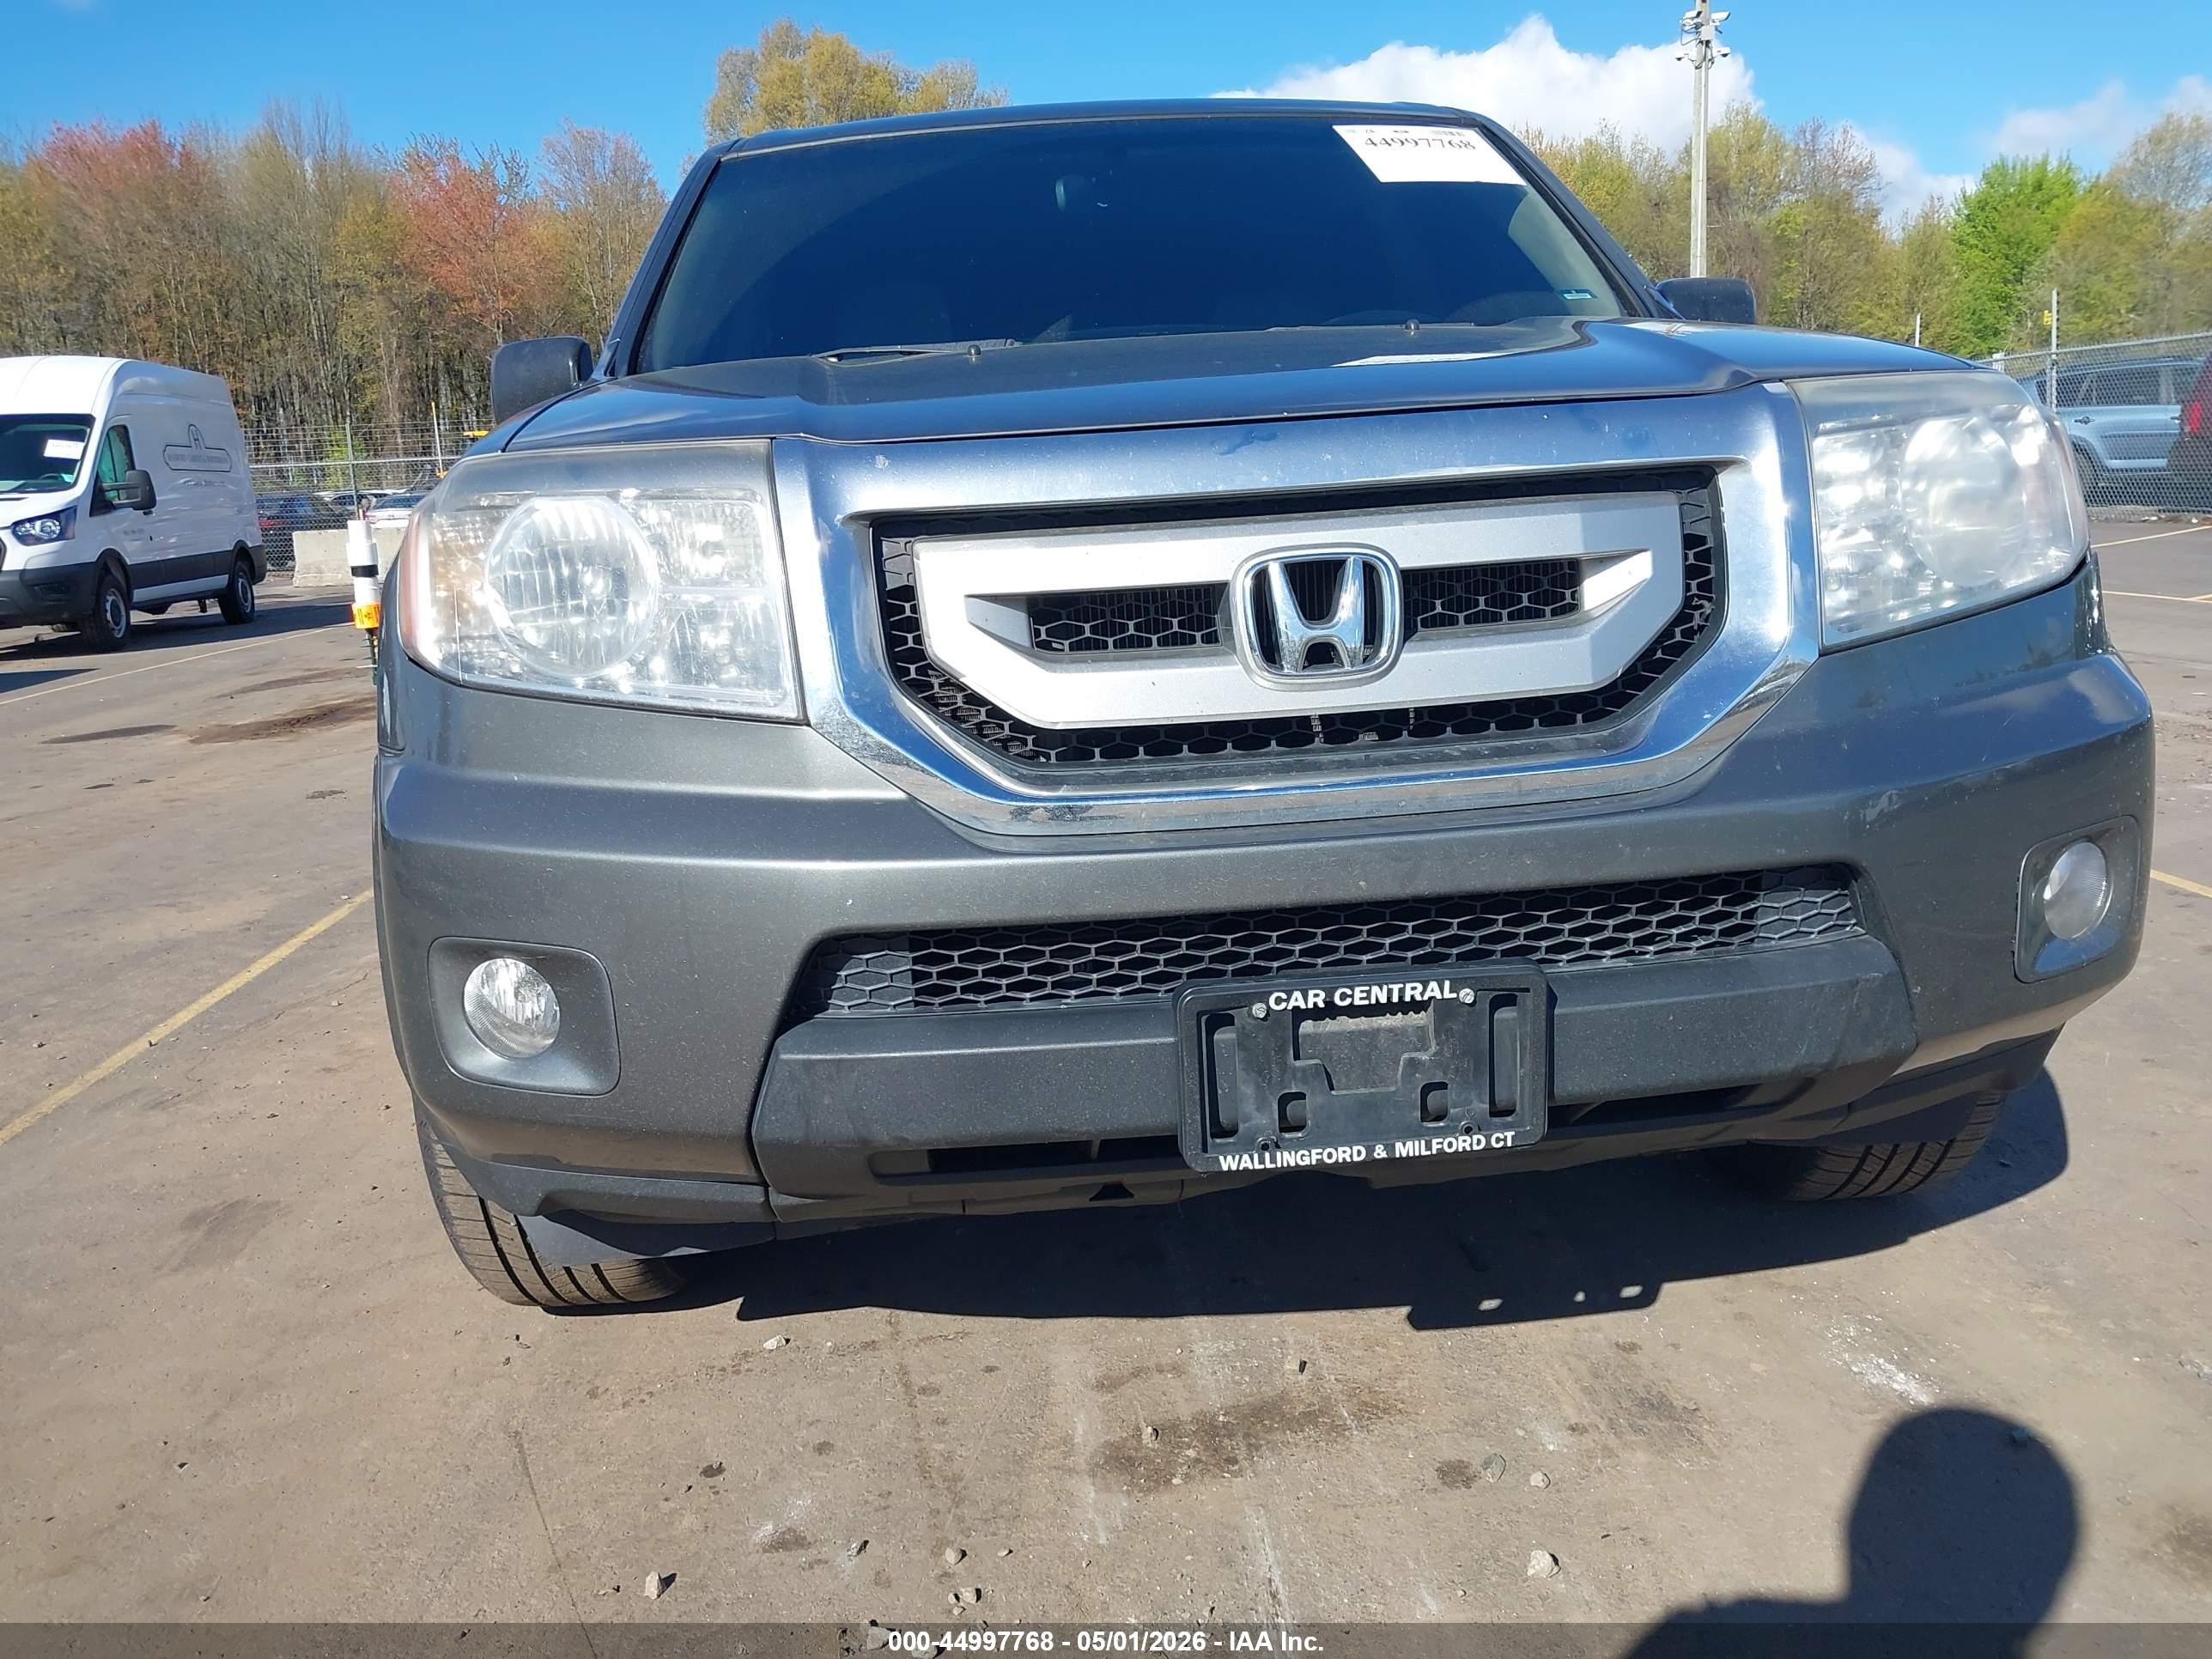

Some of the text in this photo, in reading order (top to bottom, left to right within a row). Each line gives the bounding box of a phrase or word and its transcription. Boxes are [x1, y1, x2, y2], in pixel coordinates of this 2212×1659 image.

[1365, 137, 1476, 149] 44997768
[1268, 980, 1458, 1012] CAR CENTRAL
[1218, 1131, 1516, 1171] WALLINGFORD & MILFORD CT
